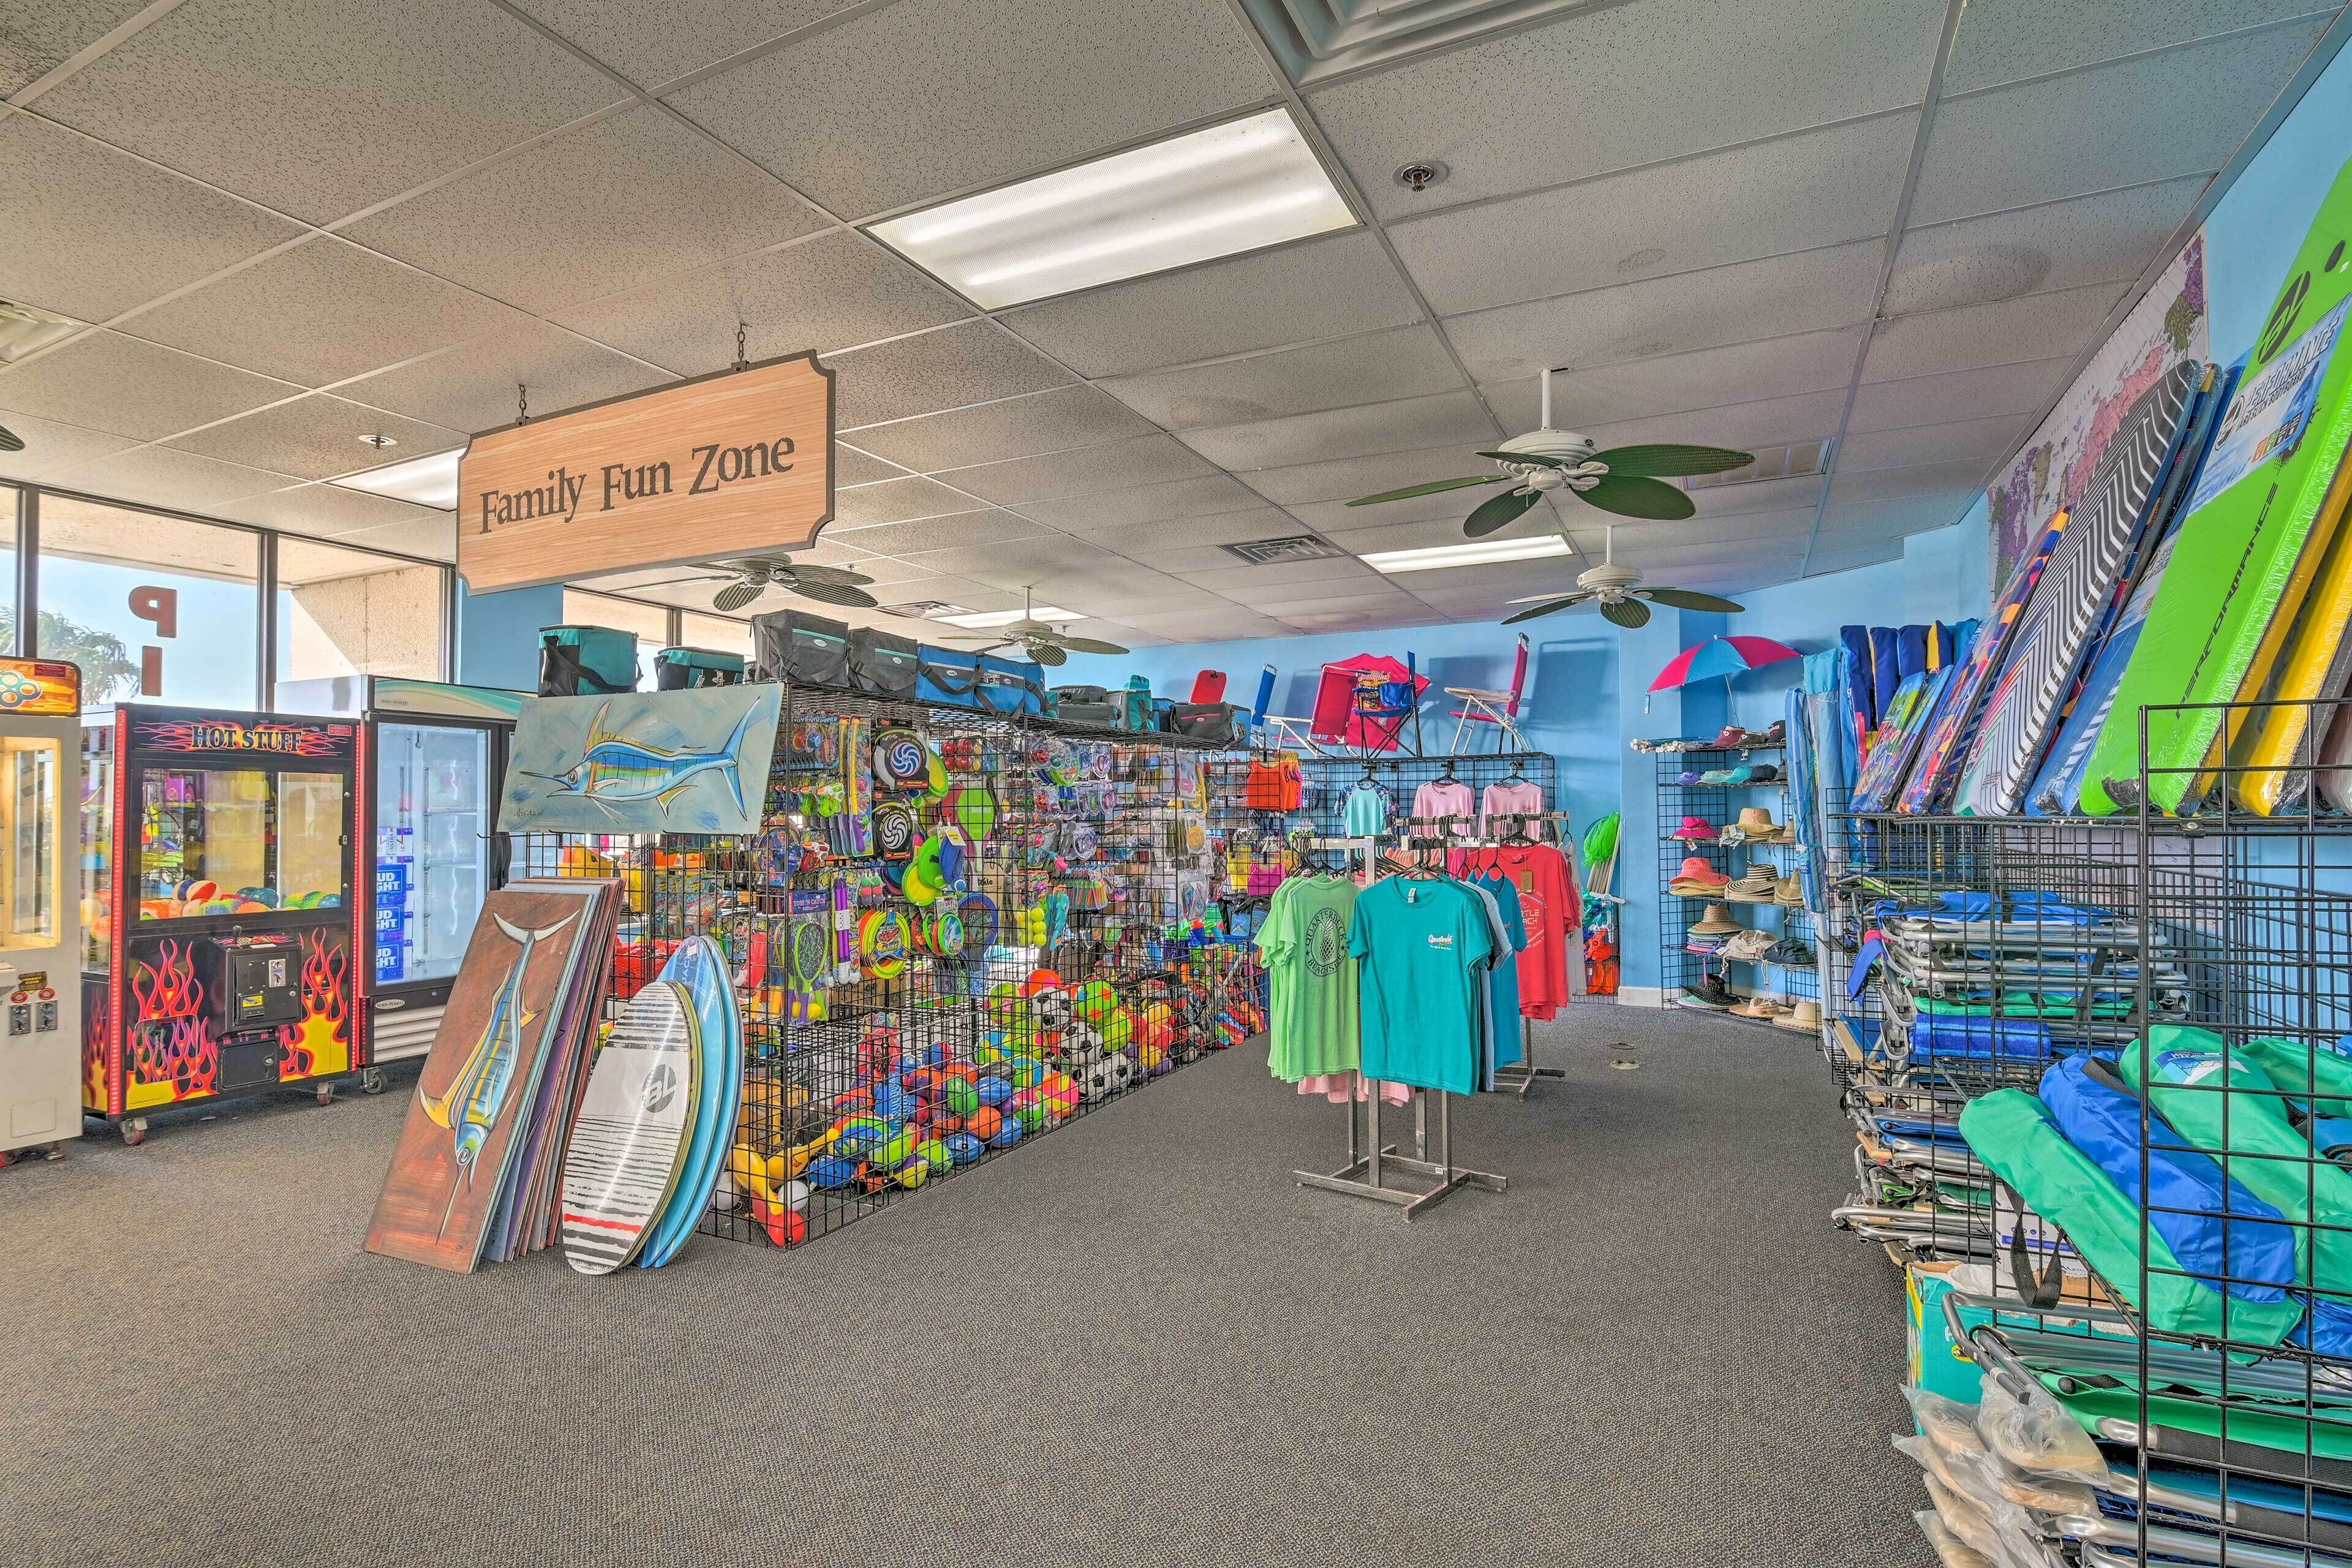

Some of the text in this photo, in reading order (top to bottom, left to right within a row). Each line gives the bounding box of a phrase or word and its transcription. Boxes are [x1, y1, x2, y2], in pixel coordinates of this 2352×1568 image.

[479, 436, 795, 535] Family Fun Zone
[192, 725, 303, 752] HOT STUFF
[377, 872, 395, 882] UD
[978, 876, 993, 886] ickle
[377, 881, 400, 892] GHT
[377, 910, 393, 919] UD
[1520, 909, 1539, 918] RTLE
[1305, 910, 1347, 946] QUARTERDECK
[1307, 954, 1343, 974] BEACHSIE
